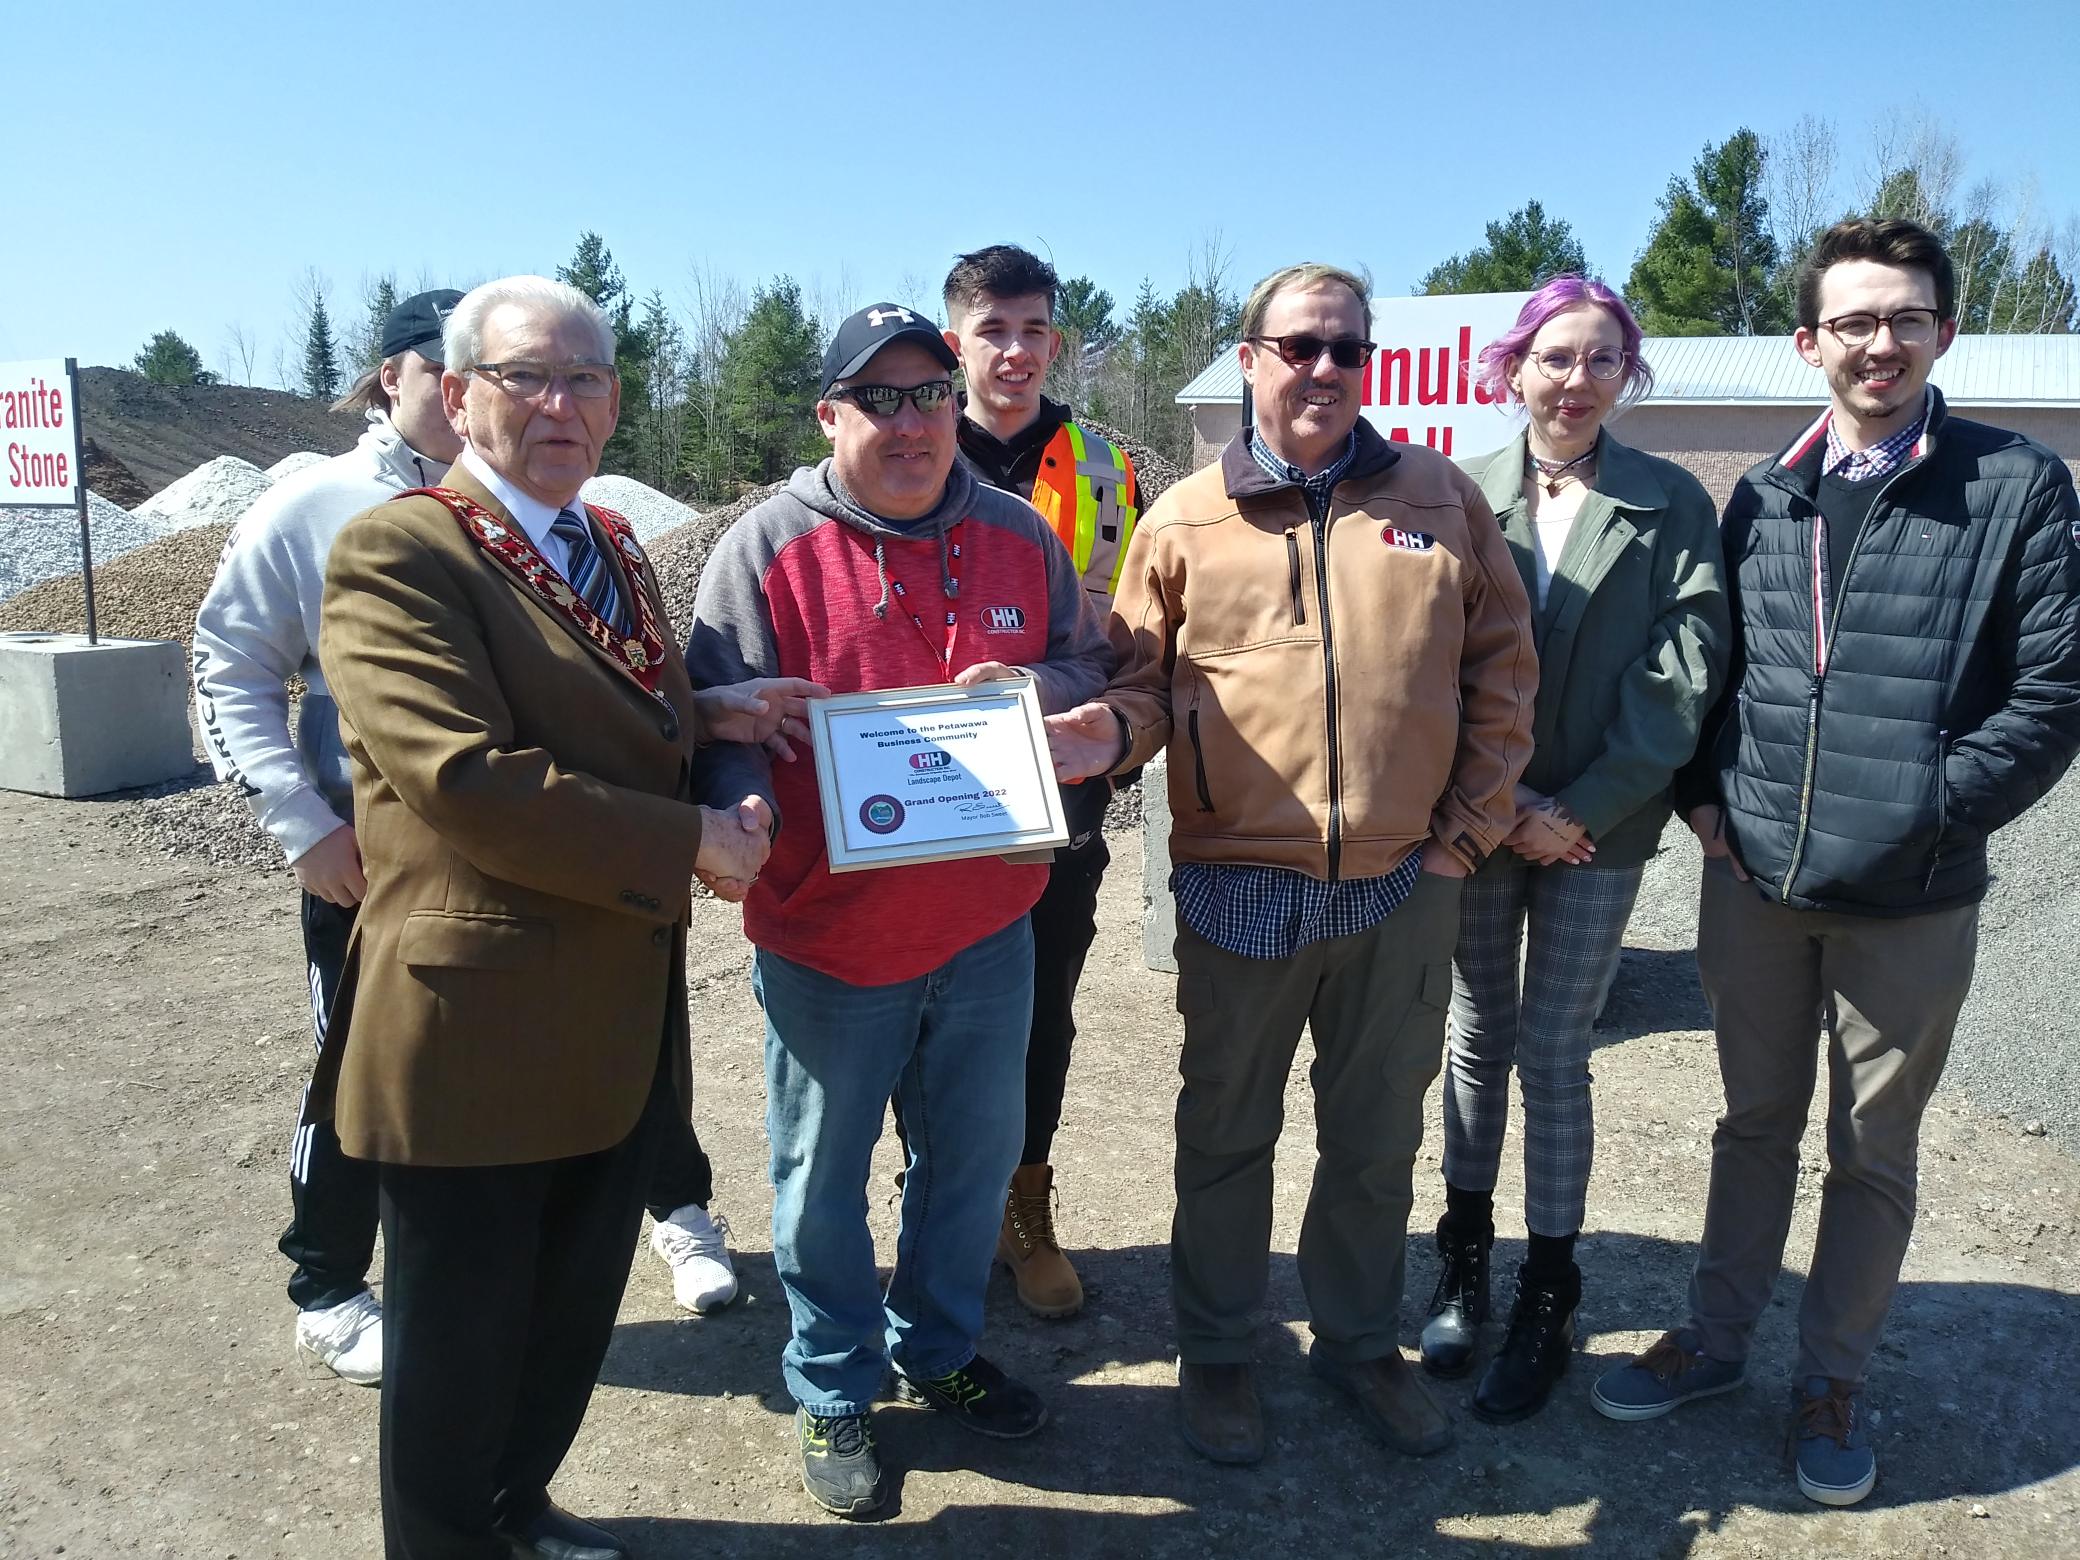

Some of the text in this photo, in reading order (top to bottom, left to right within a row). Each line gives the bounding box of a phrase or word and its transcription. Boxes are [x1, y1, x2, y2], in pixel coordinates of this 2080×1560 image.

[1361, 326, 1508, 406] nula
[0, 377, 63, 429] anite
[8, 441, 68, 487] Stone
[1392, 529, 1425, 549] HH
[990, 608, 1019, 627] HH
[860, 729, 905, 739] Welcome
[920, 725, 936, 733] the
[939, 720, 988, 731] Petawawa
[877, 732, 978, 748] Business Community
[917, 752, 944, 768] HH
[907, 773, 962, 786] Landscape Depot
[904, 788, 1007, 807] Grand Opening 2022
